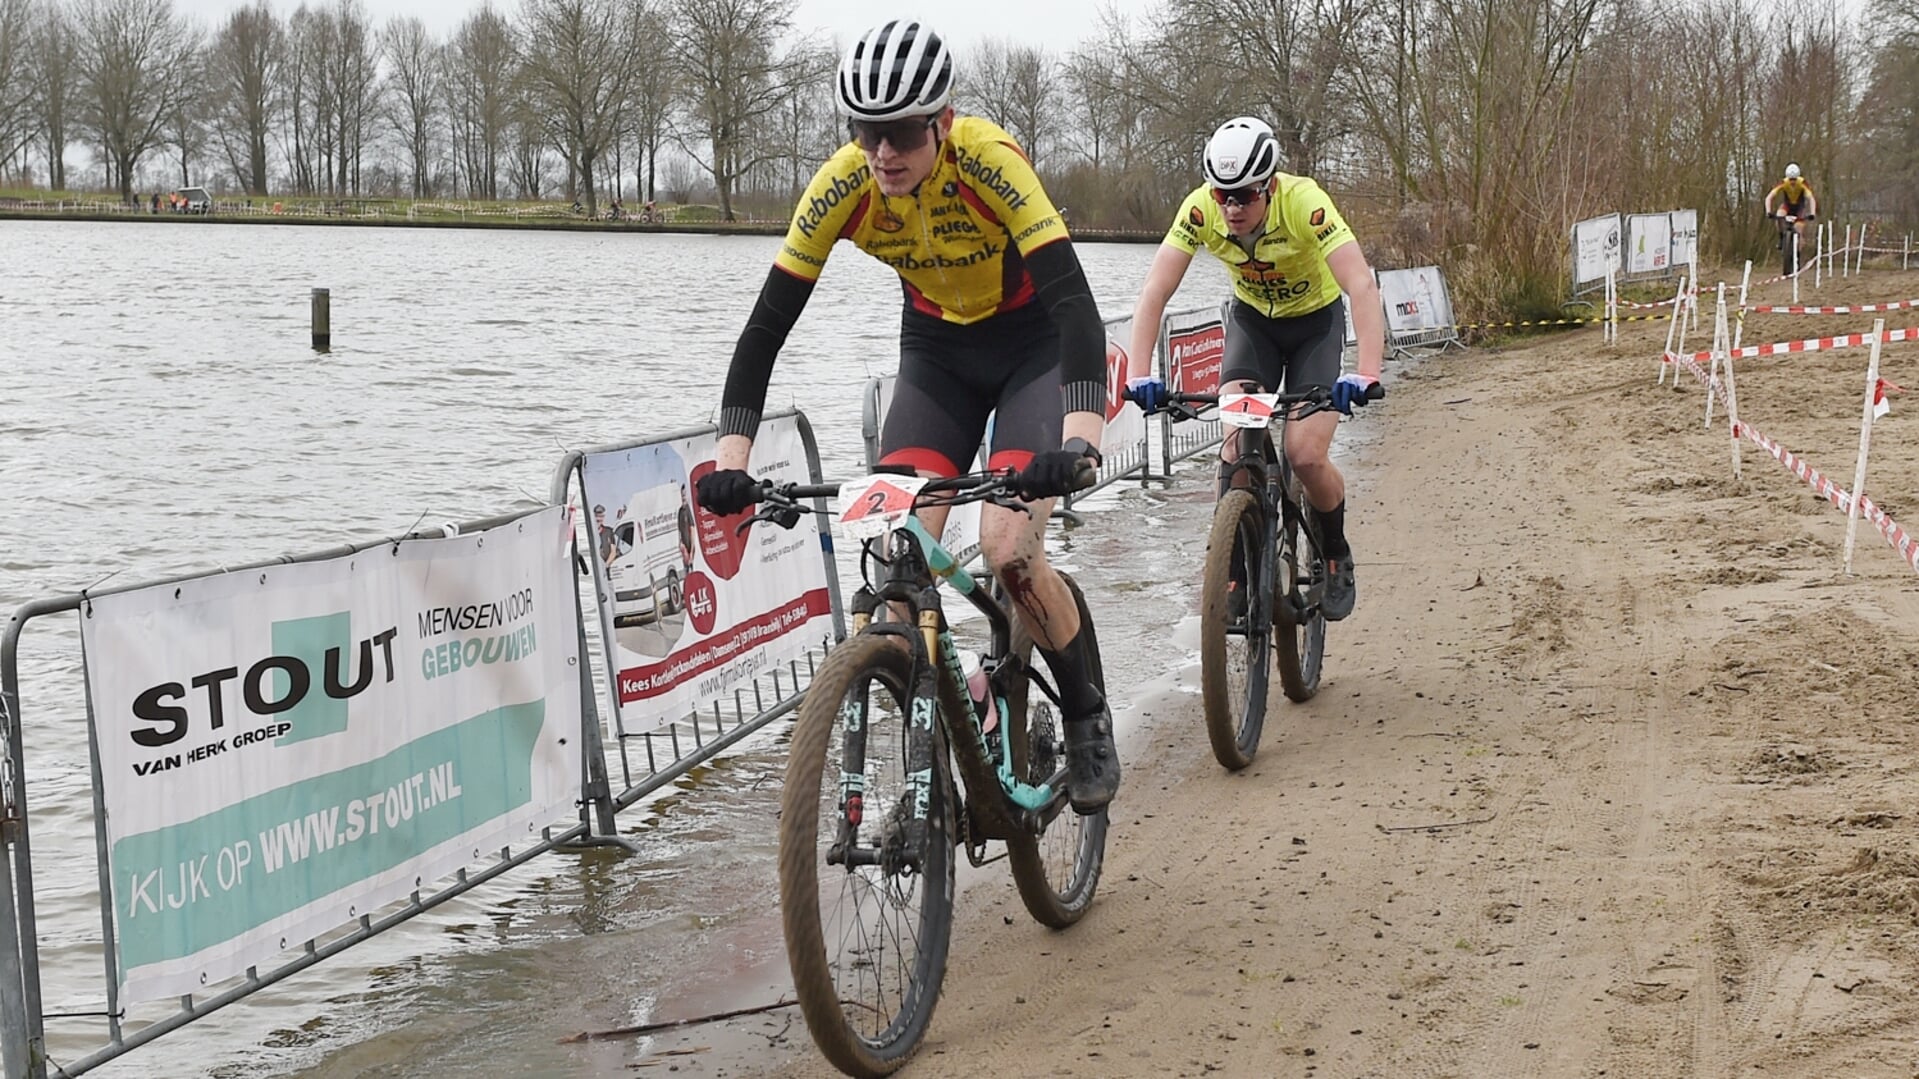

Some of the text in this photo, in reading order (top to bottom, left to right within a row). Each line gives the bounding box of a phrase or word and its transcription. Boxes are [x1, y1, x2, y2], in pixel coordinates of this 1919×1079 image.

[796, 164, 870, 239] Raboban
[1242, 402, 1249, 413] 1
[867, 492, 886, 515] 2
[418, 587, 534, 639] MENSEN VOOR
[421, 623, 538, 681] GEBOUWEN
[130, 626, 399, 748] STOUT
[622, 679, 650, 695] Kees
[132, 721, 293, 777] VAN HERK GROEP
[130, 761, 462, 919] KIJK OP WWW.STOUT.NL
